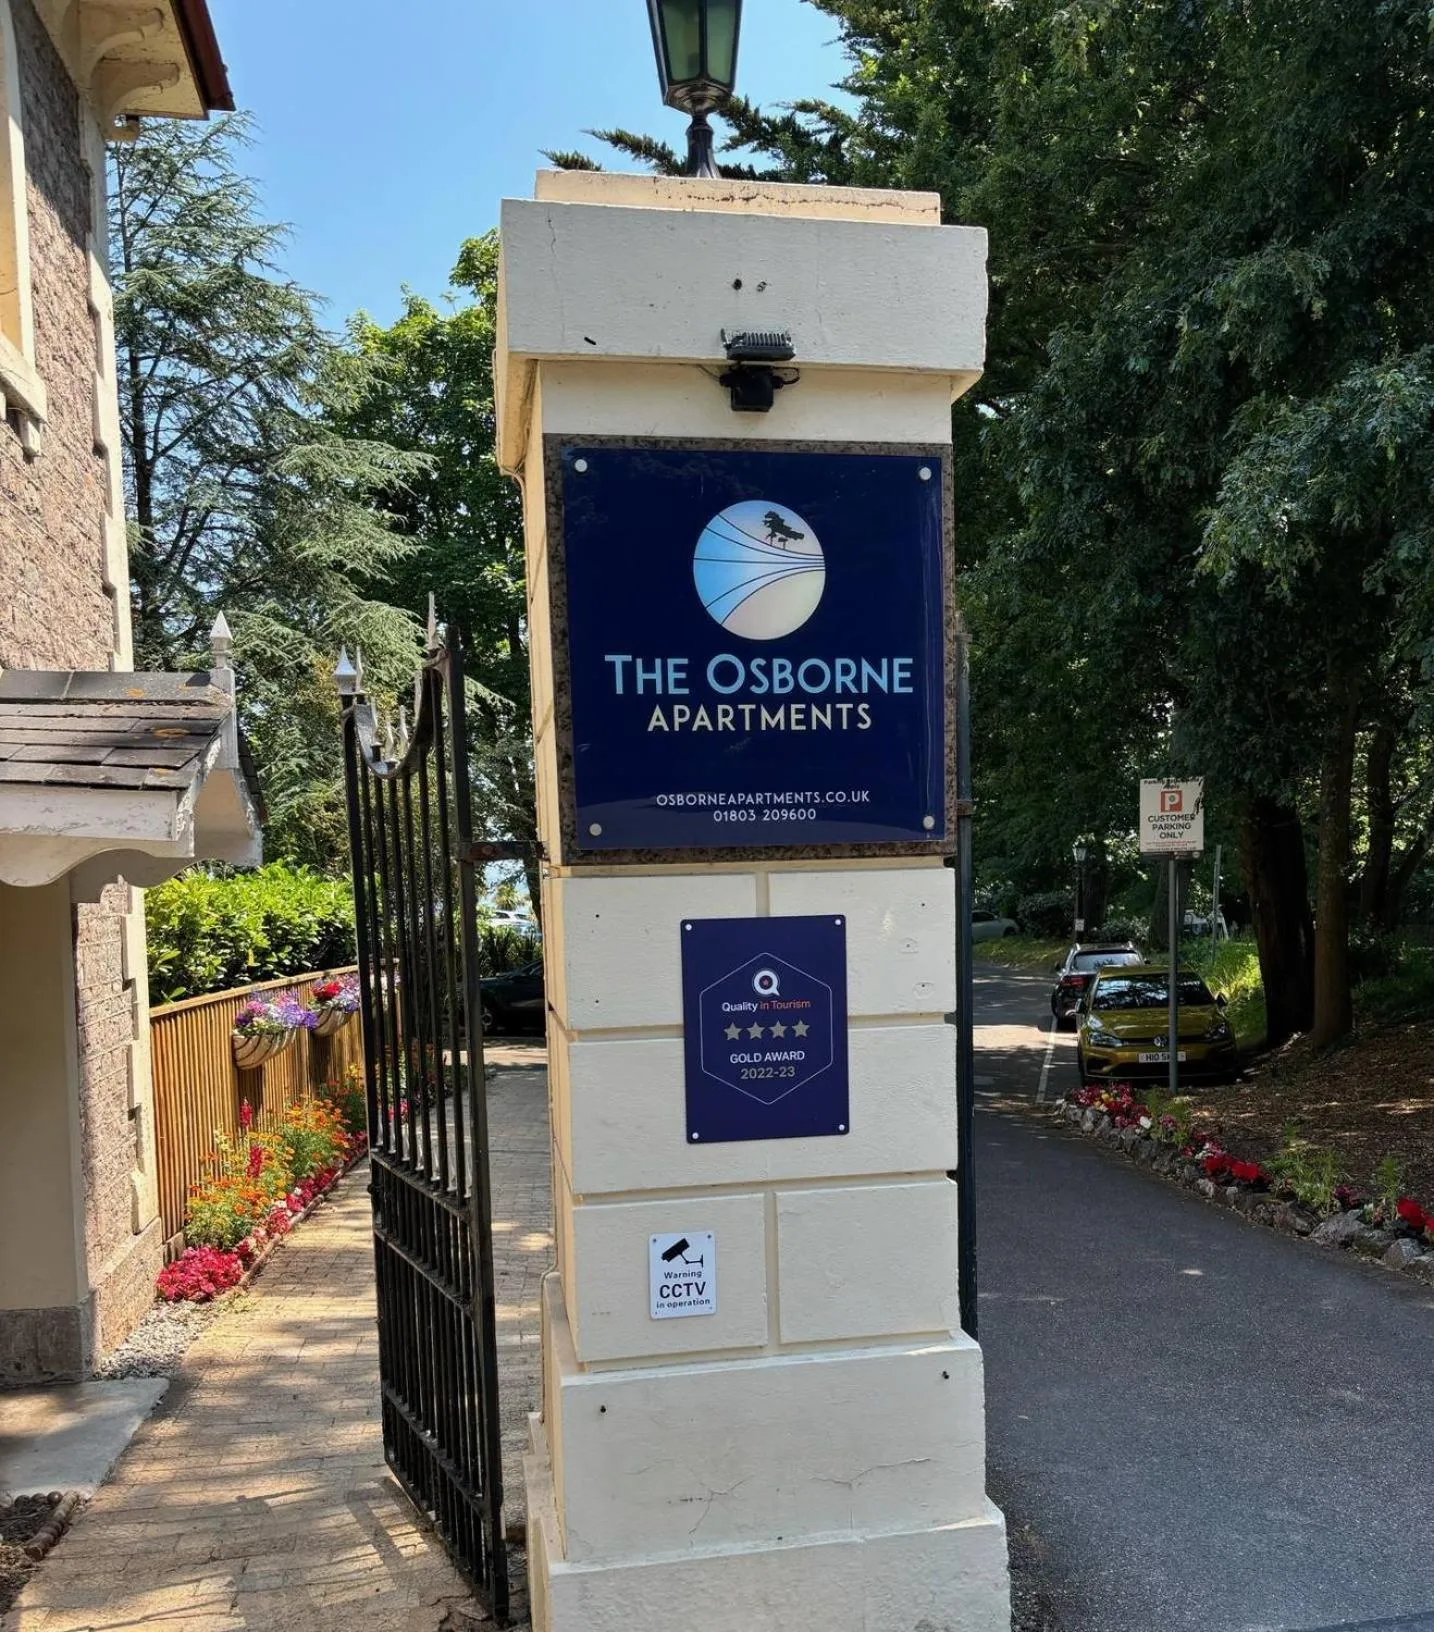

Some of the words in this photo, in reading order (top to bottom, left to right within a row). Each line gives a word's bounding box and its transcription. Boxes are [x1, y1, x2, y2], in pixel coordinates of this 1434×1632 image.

[604, 654, 690, 695] THE
[706, 653, 914, 696] OSBORNE
[647, 703, 872, 732] APARTMENTS
[656, 790, 870, 806] OSBORNEAPARTMENTS.CO.UK
[713, 810, 756, 822] 01803
[762, 808, 817, 821] 209600
[1147, 814, 1196, 823] CUSTOMER
[1152, 822, 1192, 831] PARKING
[1159, 831, 1184, 840] ONLY
[721, 1001, 758, 1013] Quality
[760, 1001, 769, 1010] in
[772, 999, 811, 1010] Tourism
[729, 1052, 762, 1064] GOLD
[764, 1050, 805, 1063] AWARD
[740, 1066, 796, 1080] 2022-23
[663, 1270, 702, 1280] Warning
[659, 1281, 707, 1299] CCTV
[656, 1301, 665, 1309] in
[667, 1298, 711, 1308] operation
